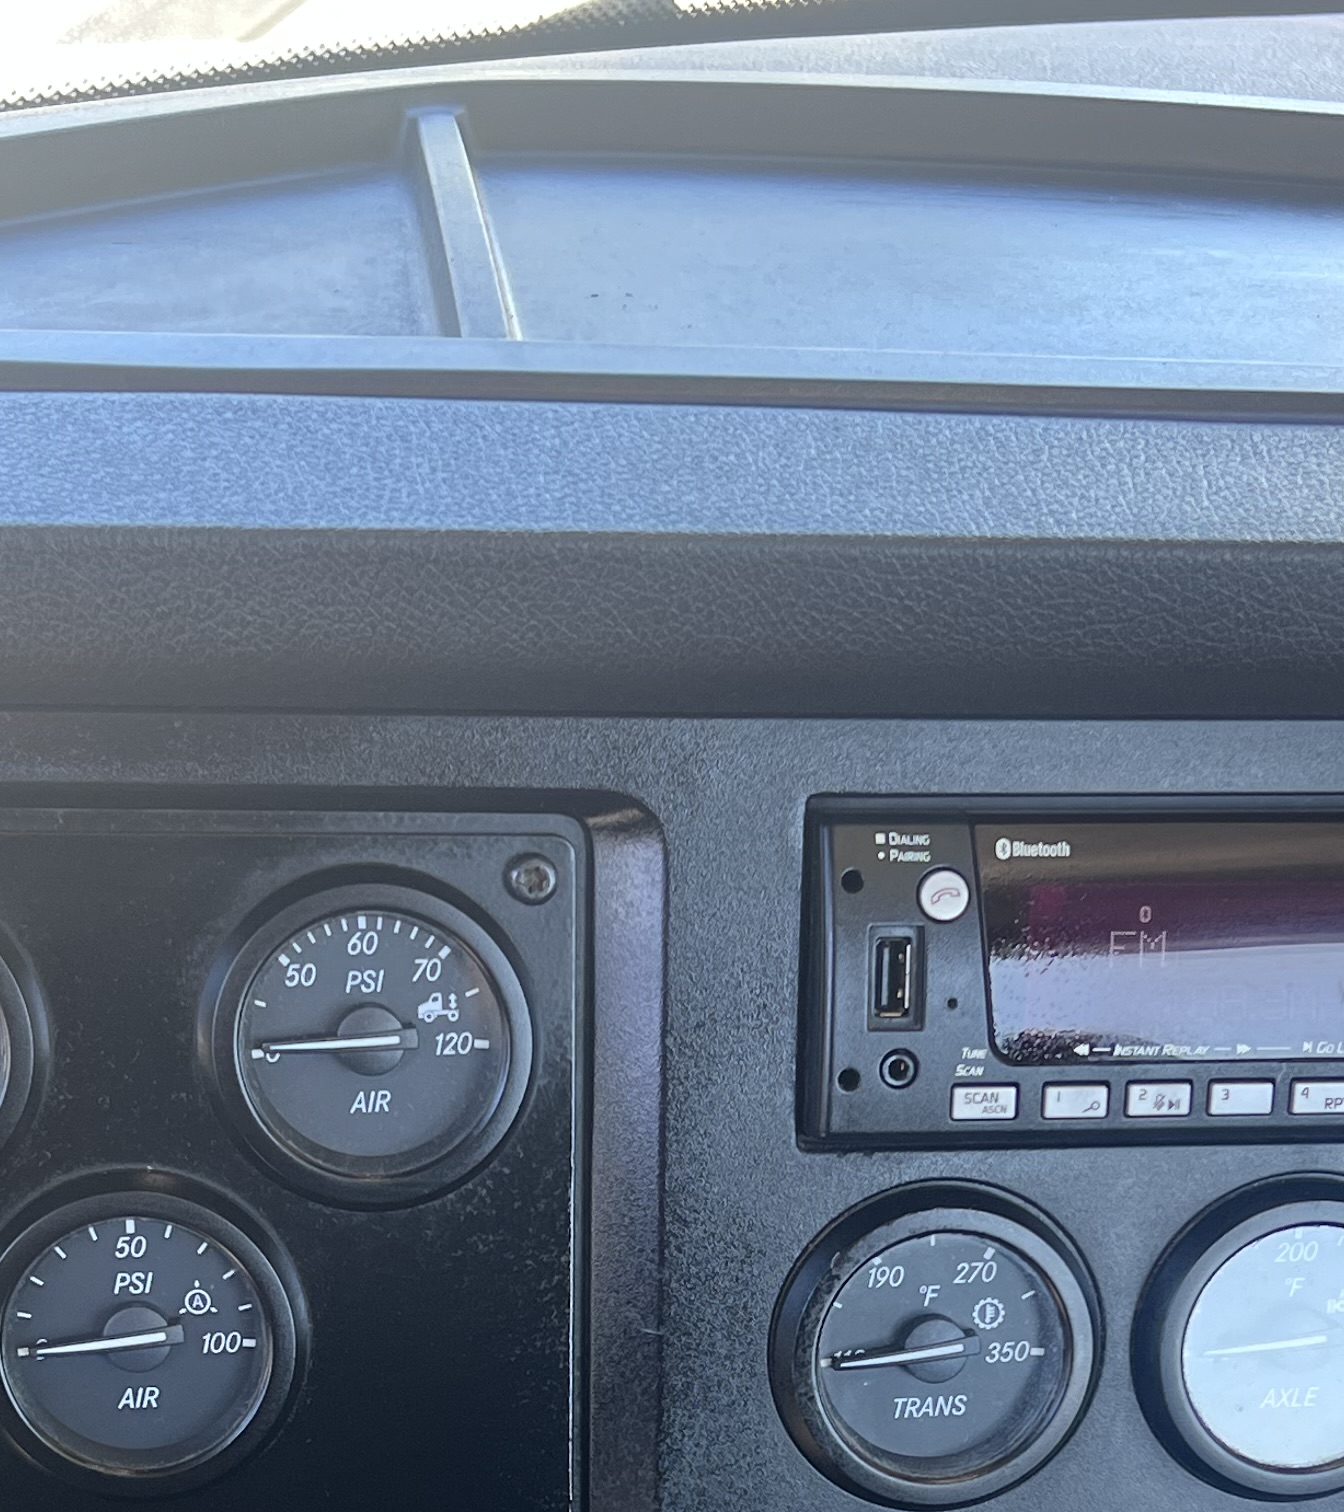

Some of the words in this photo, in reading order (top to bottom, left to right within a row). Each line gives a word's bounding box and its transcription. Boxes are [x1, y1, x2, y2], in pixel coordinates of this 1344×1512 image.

[1011, 840, 1071, 858] Bluetooth
[347, 932, 378, 955] 60
[285, 963, 317, 987] 50
[346, 969, 384, 994] PSI
[412, 958, 442, 982] 70
[435, 1032, 472, 1056] 120
[350, 1090, 391, 1114] AIR
[964, 1092, 999, 1104] SCAN
[1138, 1089, 1147, 1101] 2
[1221, 1088, 1230, 1101] 3
[1301, 1087, 1309, 1099] 4
[115, 1236, 147, 1259] 50
[1274, 1241, 1319, 1264] 200
[114, 1271, 153, 1295] PSI
[867, 1265, 905, 1288] 190
[953, 1262, 997, 1284] 270
[202, 1331, 241, 1355] 100
[984, 1341, 1030, 1364] 350
[118, 1386, 160, 1410] AIR
[893, 1395, 967, 1419] TRANS
[1260, 1386, 1319, 1410] AXLE
